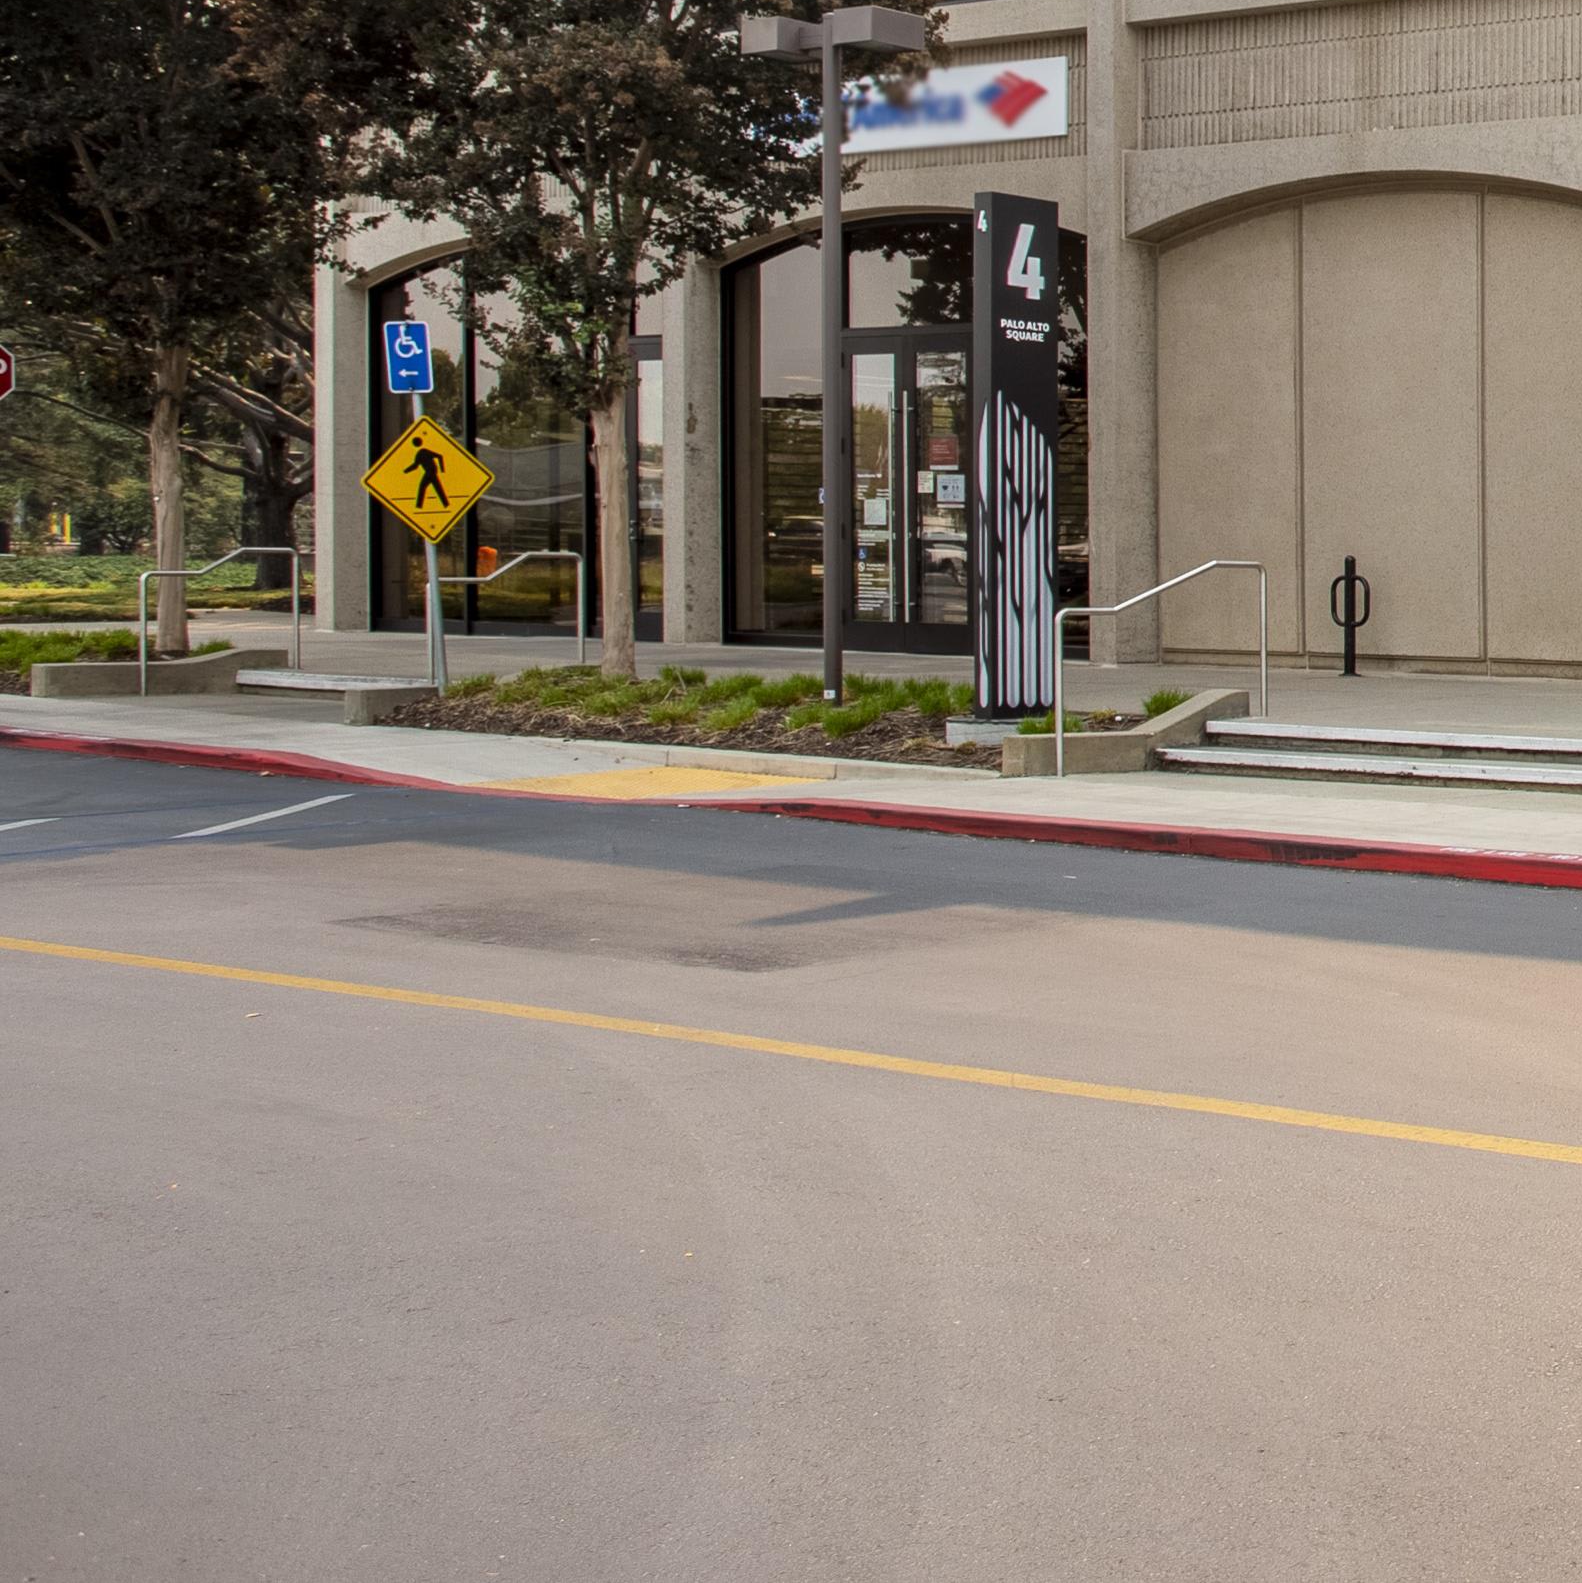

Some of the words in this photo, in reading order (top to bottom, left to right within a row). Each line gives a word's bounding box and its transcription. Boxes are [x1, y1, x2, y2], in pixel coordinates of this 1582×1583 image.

[978, 209, 988, 232] 4
[1007, 223, 1045, 300] 4
[1000, 318, 1025, 329] PALO
[1026, 321, 1050, 332] ALTO
[1006, 330, 1044, 342] SQUARE
